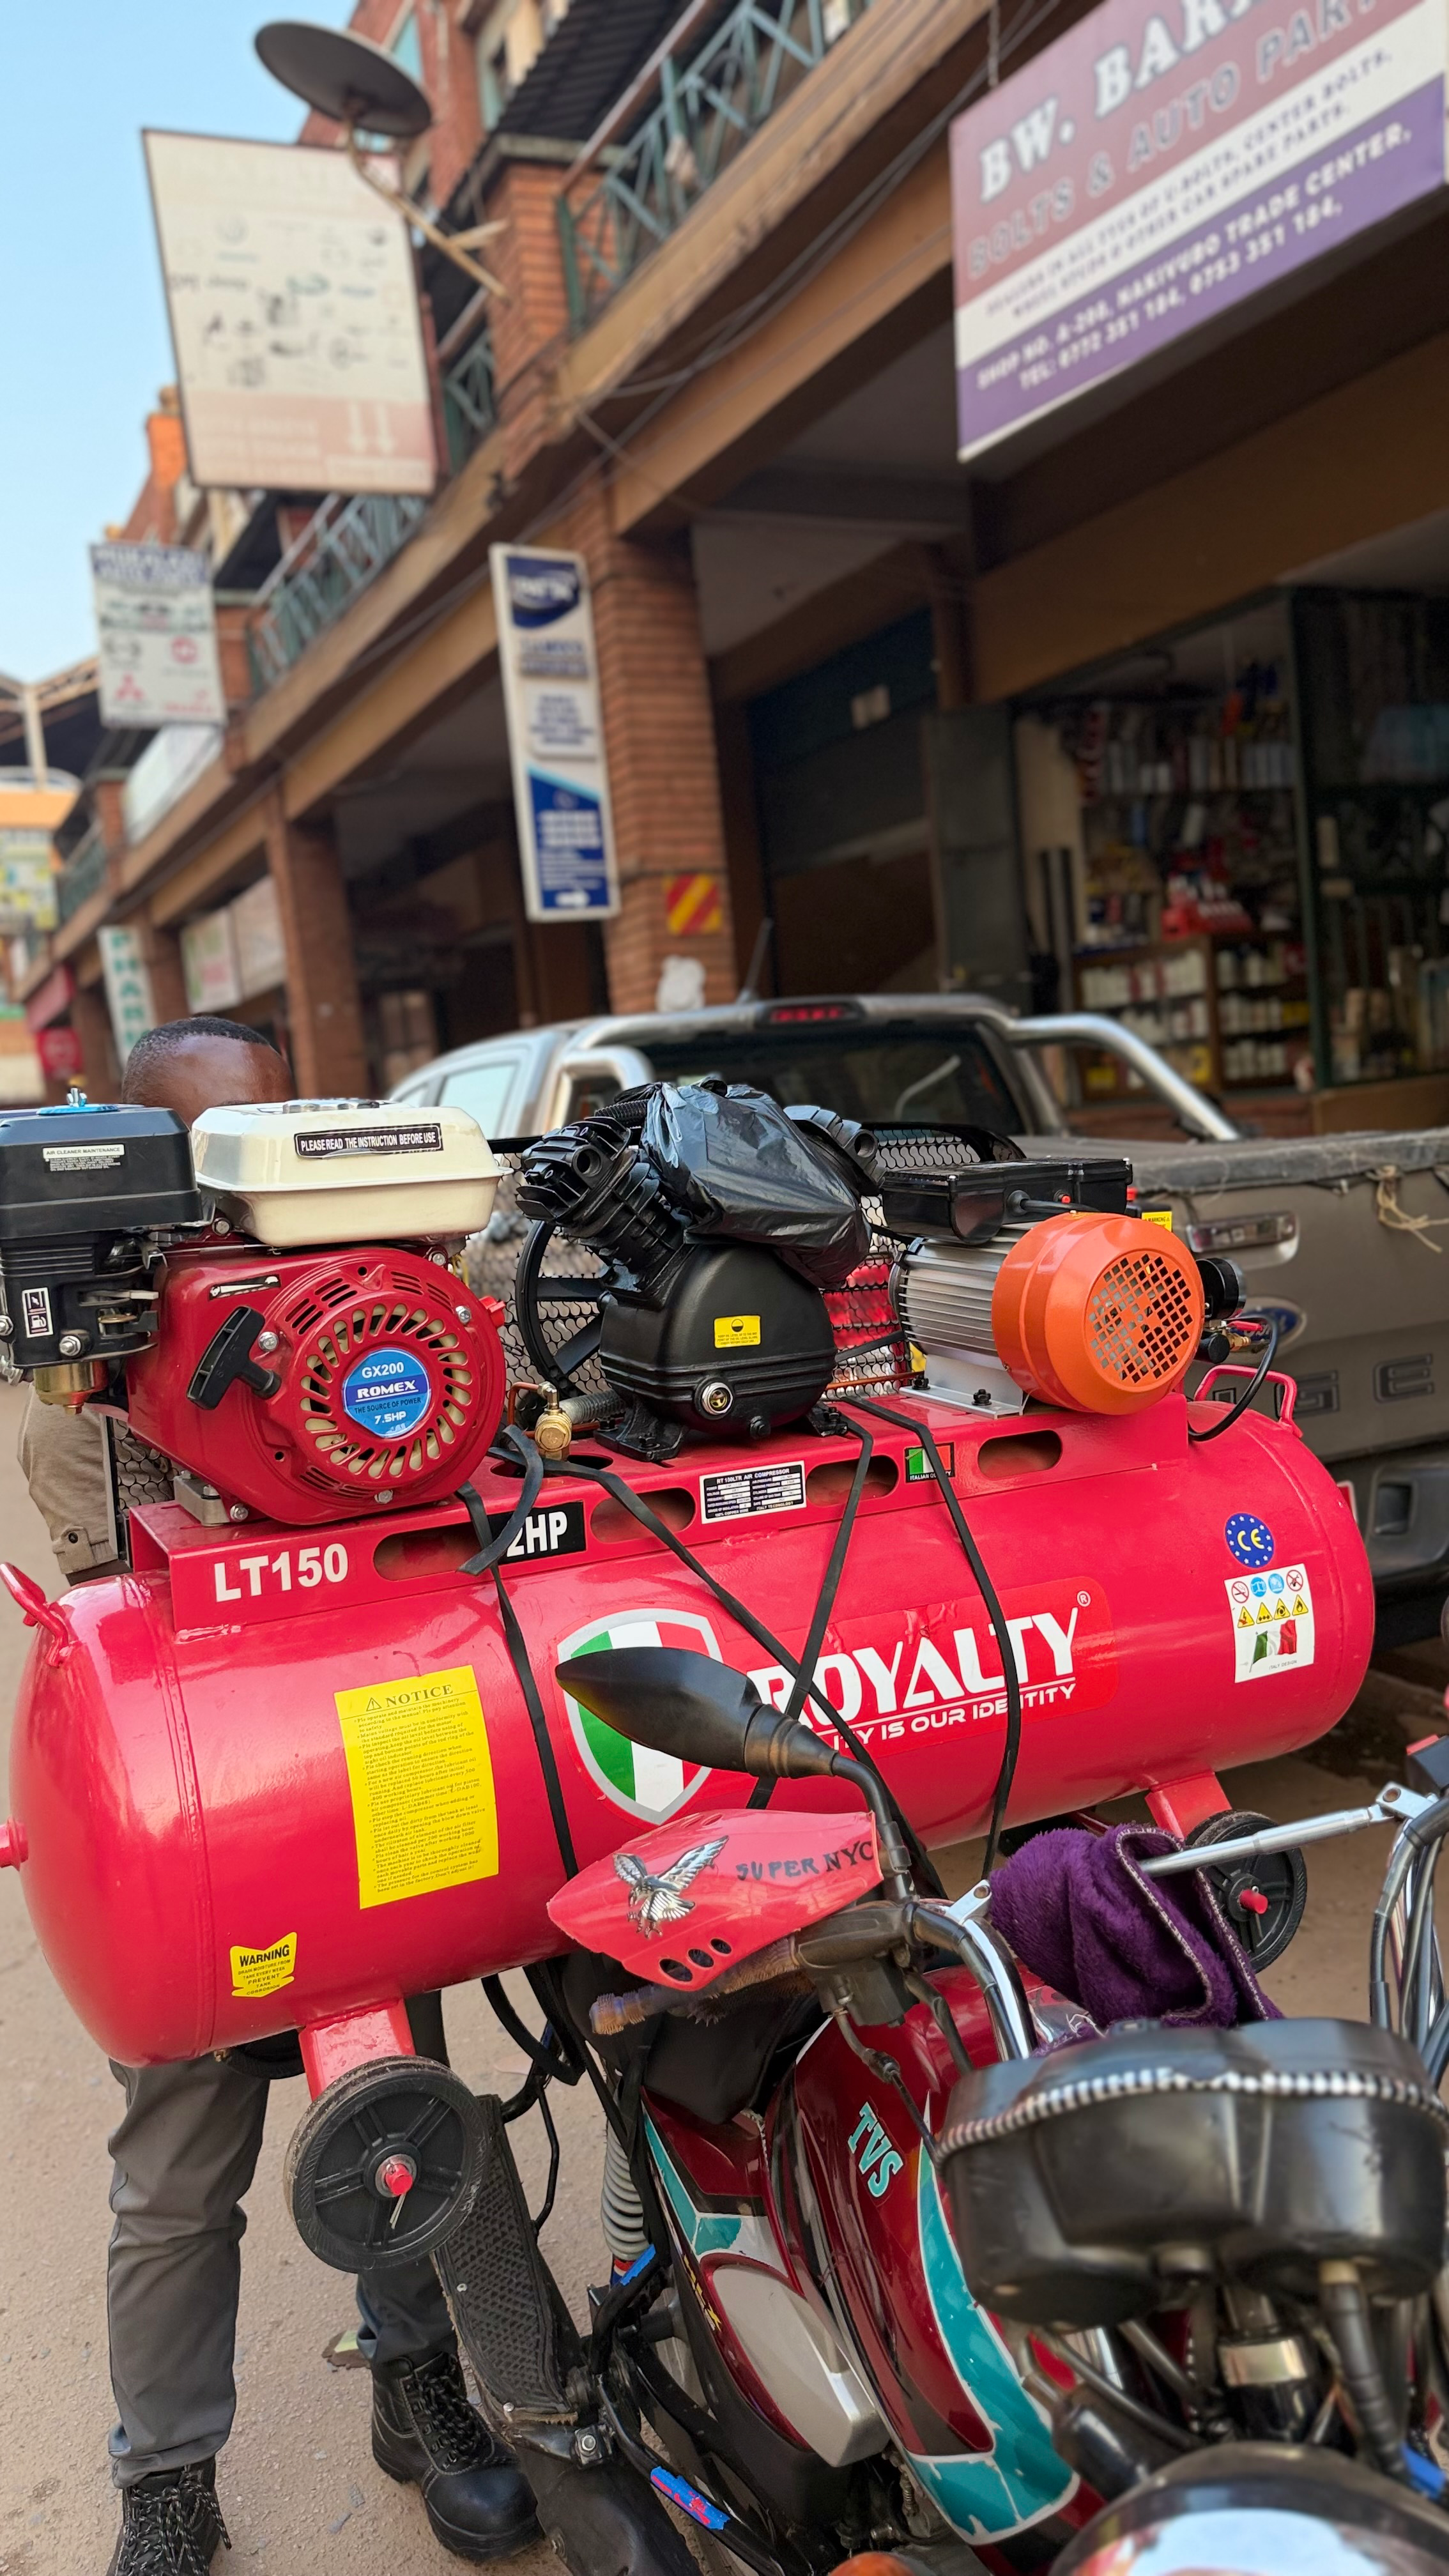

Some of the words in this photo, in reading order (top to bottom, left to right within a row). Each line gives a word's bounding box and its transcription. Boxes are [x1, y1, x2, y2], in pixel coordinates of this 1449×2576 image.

[1243, 95, 1315, 150] CENTER
[968, 177, 1074, 280] BOLTS
[1089, 150, 1115, 197] &
[1127, 63, 1240, 174] AUTO
[1256, 0, 1376, 84] PAR
[979, 96, 1075, 204] BW.
[1225, 184, 1300, 243] TRADE
[1305, 123, 1411, 195] CENTER,
[1246, 226, 1285, 263] 351
[301, 1139, 326, 1151] PLEASE
[326, 1138, 343, 1150] READ
[345, 1137, 357, 1149] THE
[358, 1134, 397, 1147] INSTRUCTION
[399, 1132, 423, 1145] BEFORE
[424, 1131, 436, 1143] USE
[362, 1361, 404, 1379] GX200
[357, 1380, 416, 1399] ROMEX
[367, 1402, 390, 1412] SOURCE
[400, 1397, 422, 1406] POWER
[374, 1411, 406, 1425] 7.5HP
[755, 1468, 790, 1478] COMPRESSOR
[1237, 1528, 1264, 1551] CE
[215, 1543, 348, 1602] LT150
[747, 1607, 1078, 1729] ROYALTY
[385, 1683, 453, 1708] NOTICE
[882, 1721, 905, 1740] IS
[910, 1708, 966, 1733] OUR
[972, 1683, 1076, 1720] IDETITY
[736, 1858, 819, 1880] SUPER
[823, 1841, 874, 1872] NYC
[240, 1944, 289, 1967] WARNING
[254, 1963, 277, 1972] MOISTURE
[247, 1984, 280, 1995] CORROSION
[248, 1973, 280, 1984] PREVENT
[848, 2101, 903, 2197] TVS
